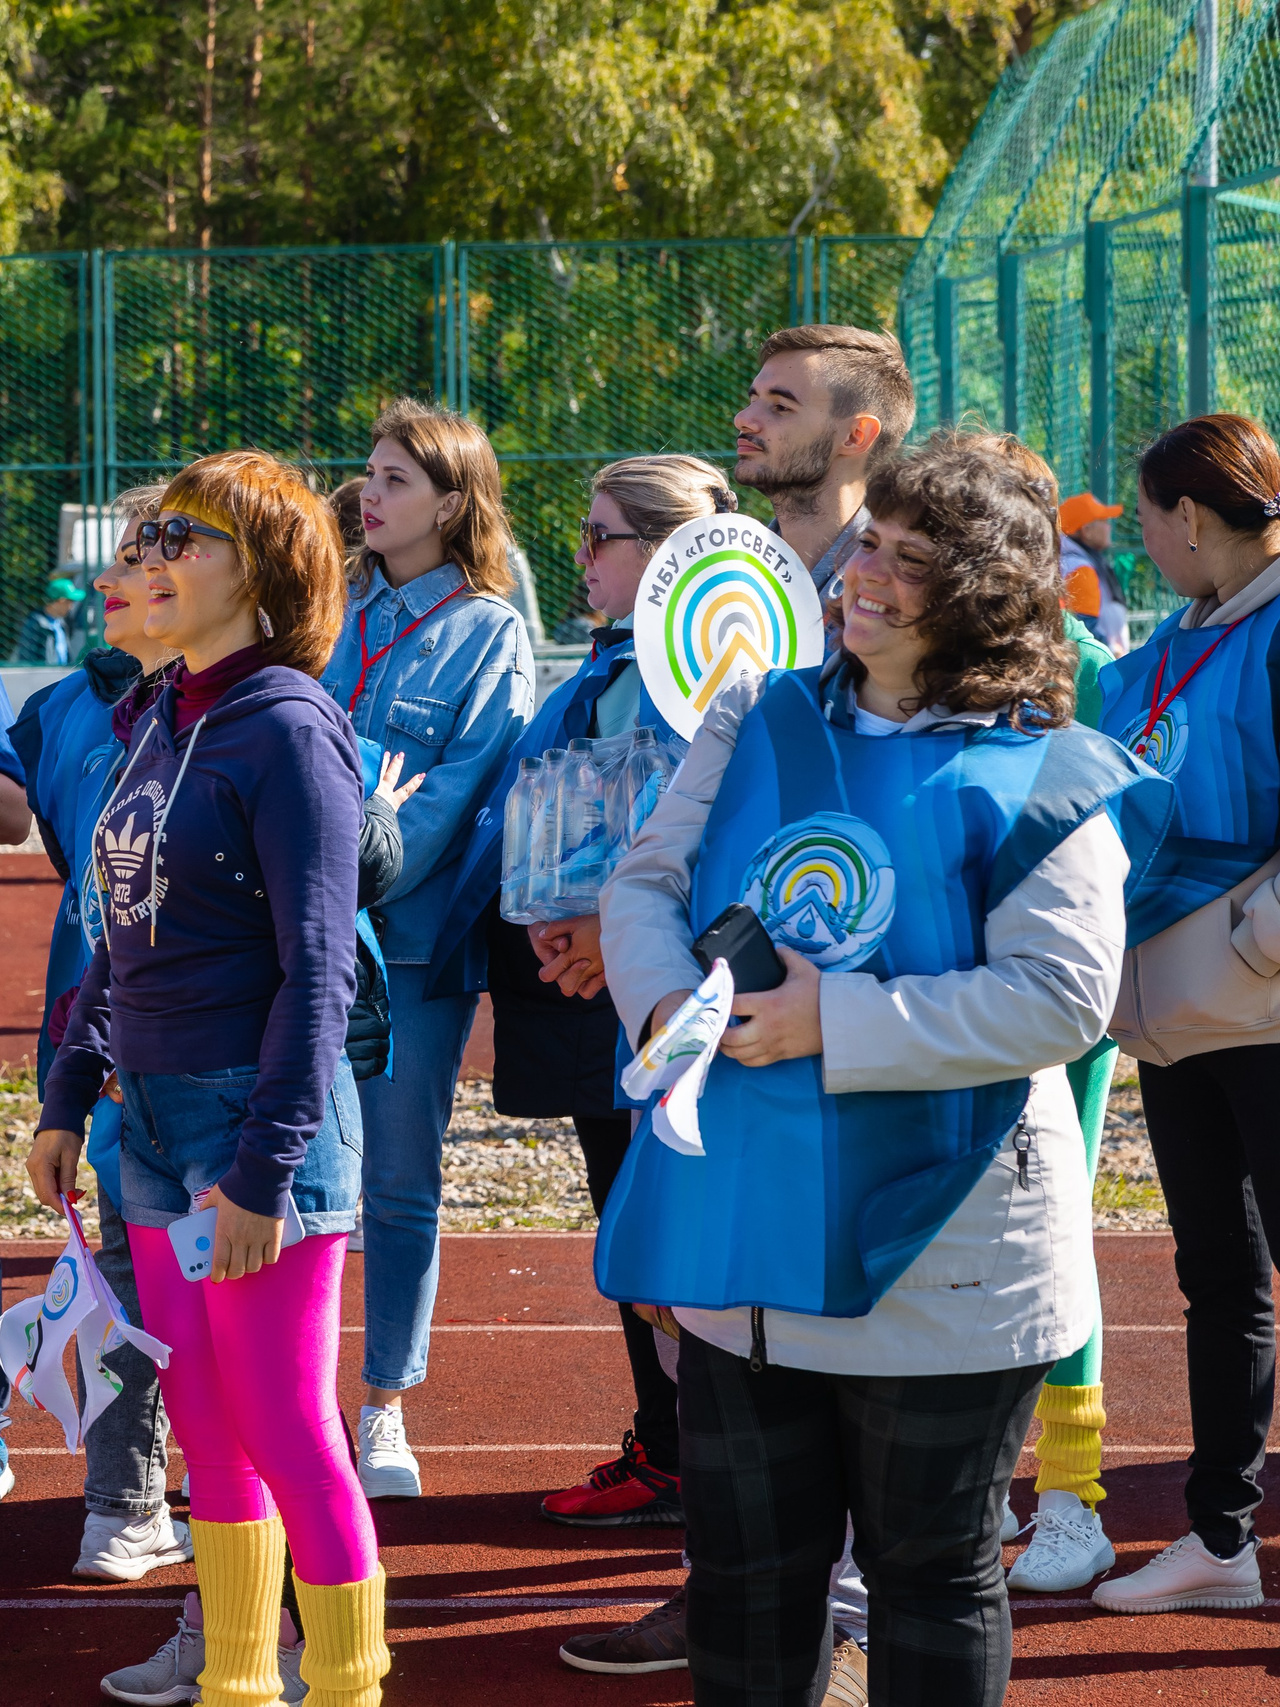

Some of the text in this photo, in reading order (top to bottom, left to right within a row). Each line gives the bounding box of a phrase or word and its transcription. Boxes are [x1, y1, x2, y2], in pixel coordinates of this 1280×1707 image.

[647, 527, 792, 607] МБУ «ГОРСВЕТ»
[97, 783, 143, 837] ADIDAS
[113, 882, 131, 904] 1972
[114, 907, 132, 926] THE
